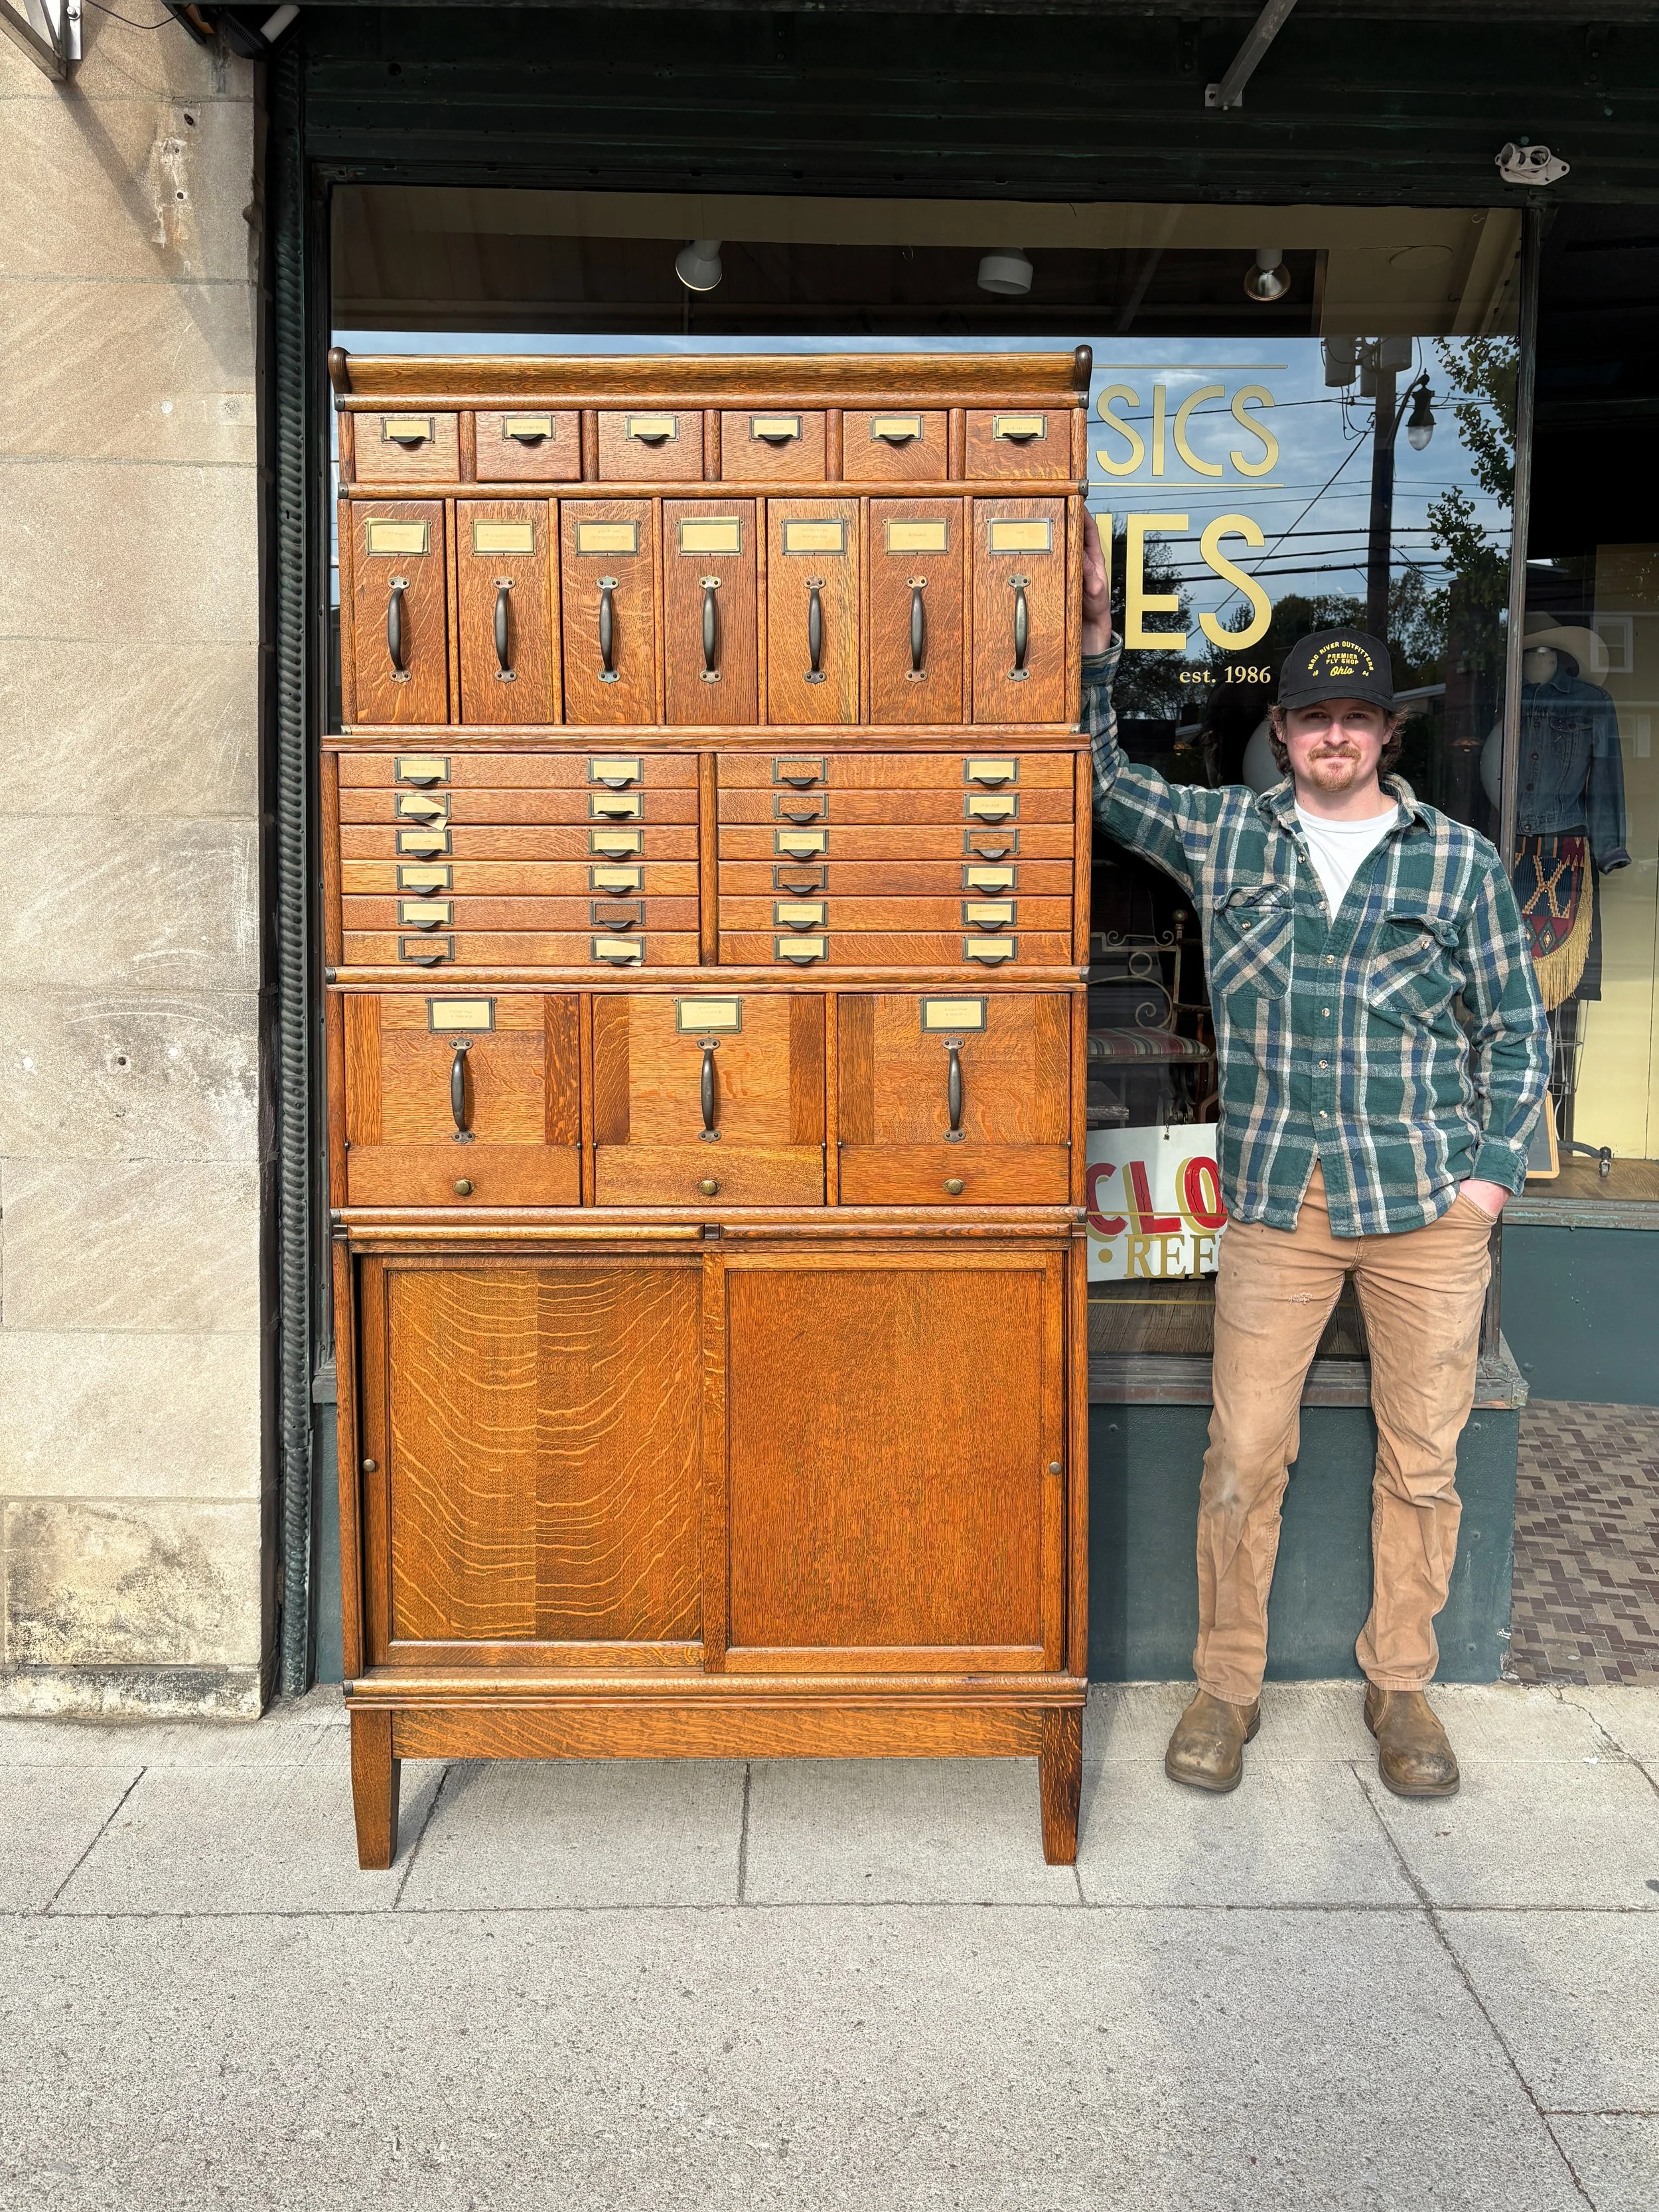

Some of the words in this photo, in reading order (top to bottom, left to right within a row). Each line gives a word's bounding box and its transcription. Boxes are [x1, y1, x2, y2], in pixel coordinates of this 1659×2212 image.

[1086, 384, 1279, 477] SICS
[1308, 654, 1319, 670] MAD
[1319, 642, 1340, 654] RIVER
[1342, 641, 1374, 671] OUTFITTERS
[1179, 669, 1216, 684] est.
[1224, 666, 1271, 684] 1986
[1330, 666, 1354, 677] Ohio
[1123, 1234, 1223, 1280] REF
